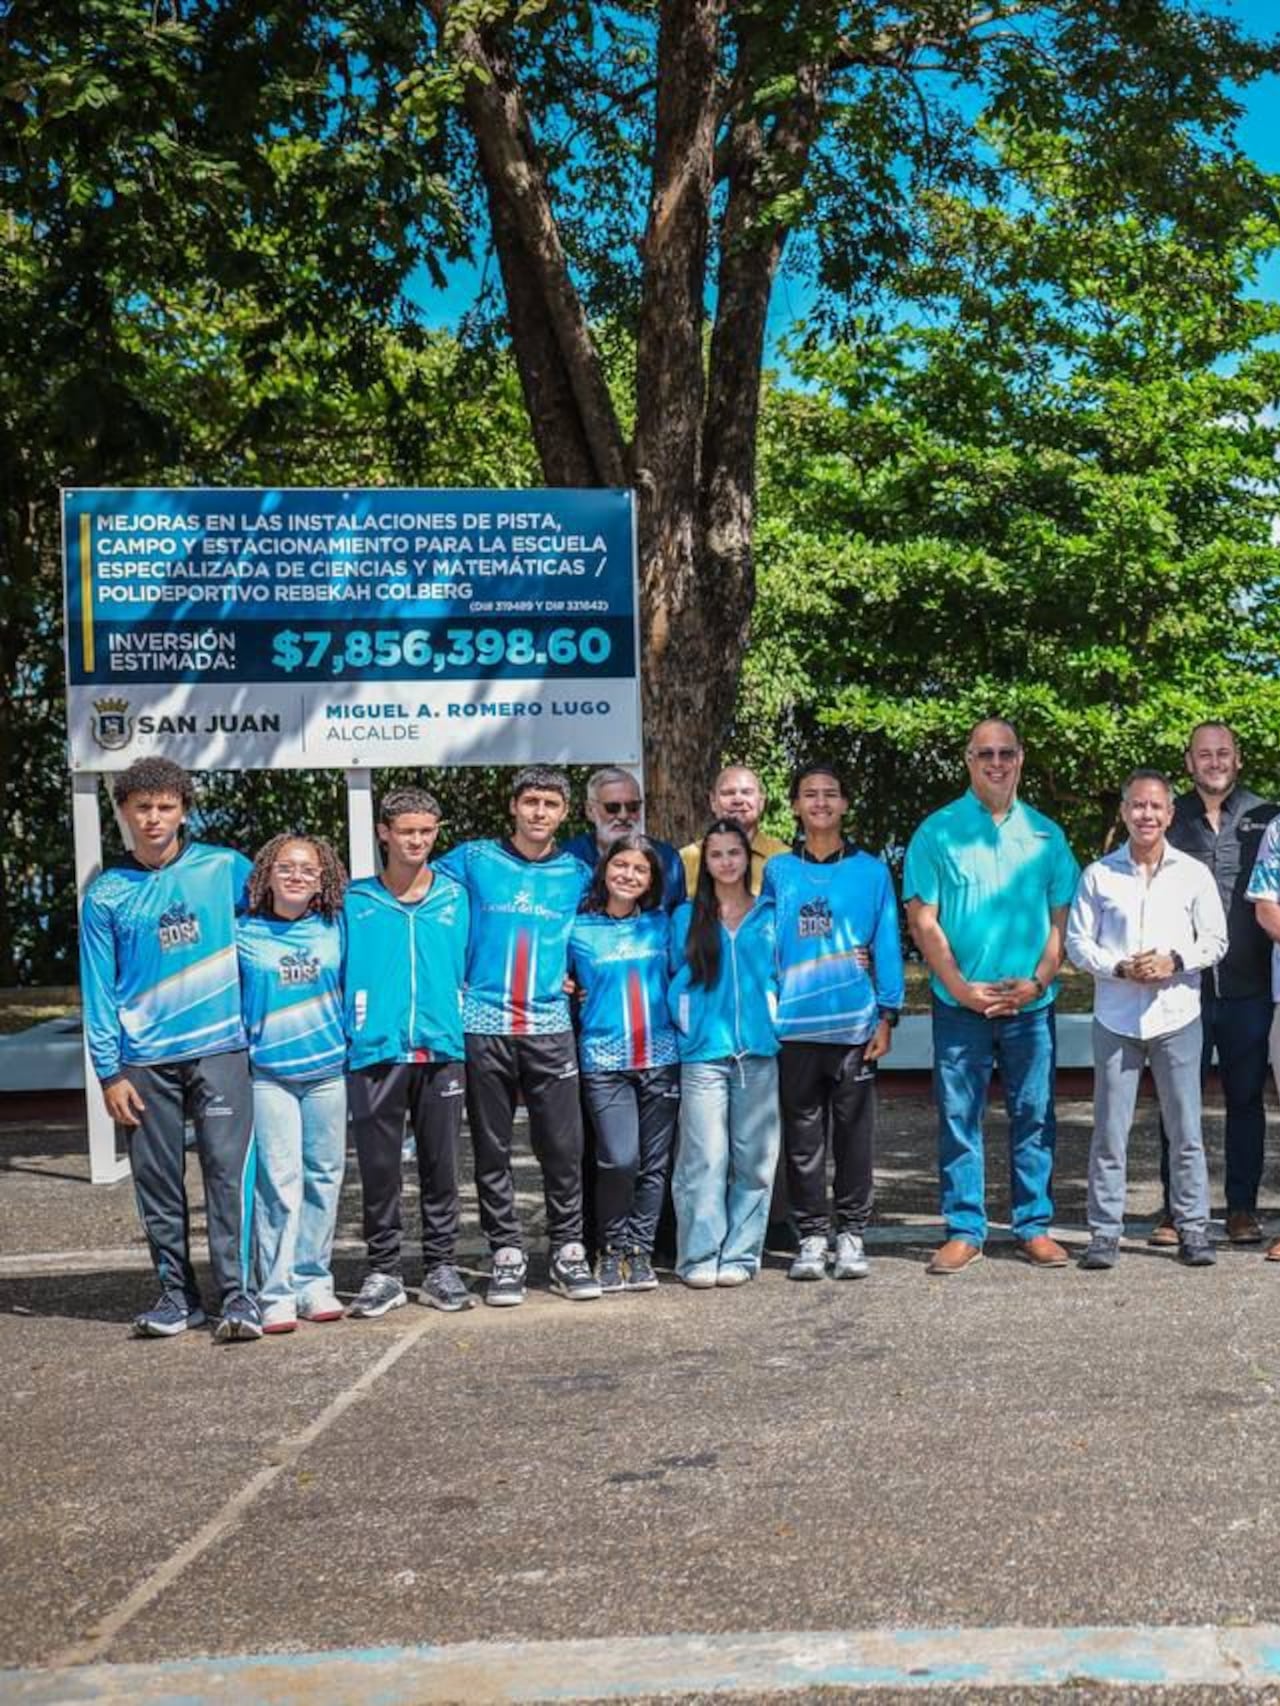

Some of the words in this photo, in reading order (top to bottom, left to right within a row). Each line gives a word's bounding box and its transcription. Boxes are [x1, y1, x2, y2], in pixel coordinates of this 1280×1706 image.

[97, 514, 200, 532] MEJORAS
[206, 514, 235, 531] EN
[241, 514, 283, 531] LAS
[288, 513, 457, 531] INSTALACIONES
[463, 513, 491, 529] DE
[497, 513, 561, 532] PISTA,
[97, 538, 176, 555] CAMPO
[182, 538, 197, 554] Y
[202, 537, 409, 554] ESTACIONAMIENTO
[415, 537, 473, 553] PARA
[479, 536, 507, 552] LA
[512, 536, 607, 552] ESCUELA
[98, 561, 270, 578] ESPECIALIZADA
[276, 561, 305, 577] DE
[310, 560, 407, 577] CIENCIAS
[413, 560, 427, 576] Y
[433, 555, 585, 576] MATEMÁTICAS
[99, 585, 269, 602] POLIDEPORTIVO
[275, 584, 371, 600] REBEKAH
[375, 583, 473, 600] COLBERG
[108, 628, 236, 651] INVERSIÓN
[272, 627, 611, 673] $7,856,398.60
[111, 653, 236, 671] ESTIMADA:
[326, 704, 409, 719] MIGUEL
[417, 703, 439, 718] A.
[448, 702, 542, 717] ROMERO
[552, 701, 611, 715] LUGO
[138, 715, 197, 734] SAN
[205, 714, 281, 733] JUAN
[326, 725, 420, 741] ALCALDE
